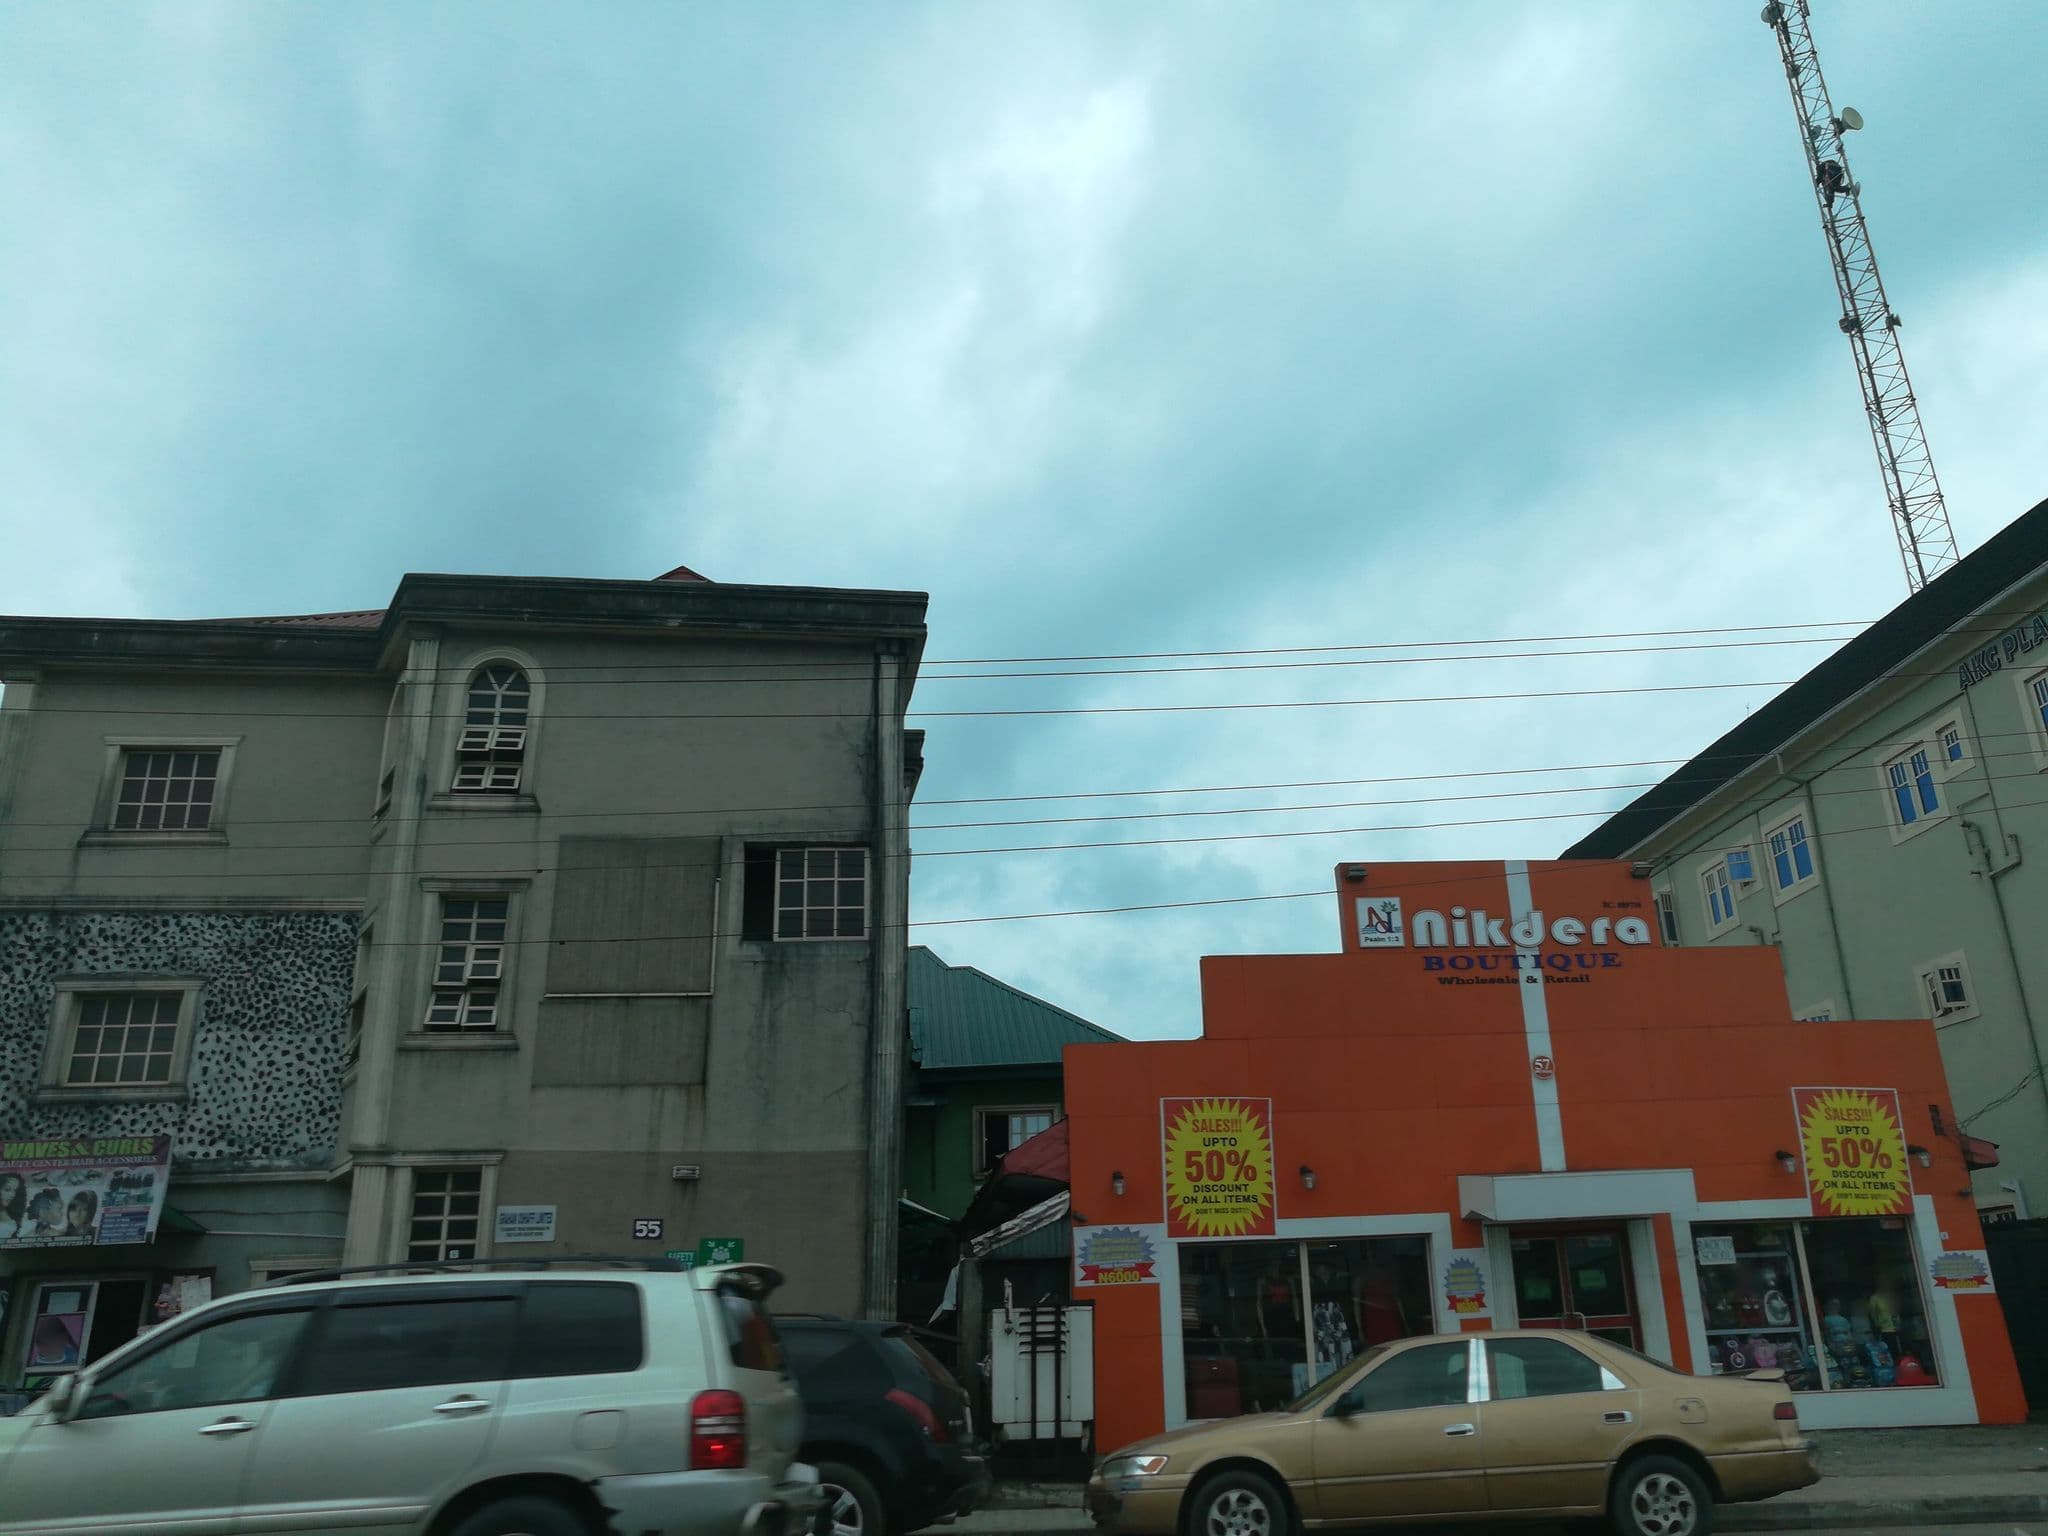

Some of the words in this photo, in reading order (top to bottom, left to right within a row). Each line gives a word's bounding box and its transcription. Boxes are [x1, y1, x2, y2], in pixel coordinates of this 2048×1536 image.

[1958, 645, 2001, 691] AKC
[1423, 952, 1623, 972] BOUTIQUE
[1438, 975, 1519, 985] Wholesale
[1526, 975, 1539, 985] &
[1545, 974, 1591, 985] Retail
[1192, 1118, 1243, 1133] SALES!!!
[3, 1141, 71, 1160] WAVES
[1821, 1137, 1893, 1169] 50%
[1184, 1149, 1257, 1183] 50%
[1832, 1169, 1886, 1179] DISCOUNT
[1193, 1184, 1249, 1193] DISCOUNT
[1823, 1180, 1838, 1189] ON
[1841, 1181, 1860, 1189] ALL
[1863, 1181, 1896, 1190] ITEMS
[1182, 1196, 1198, 1204] ON
[1202, 1195, 1220, 1204] ALL
[1224, 1194, 1258, 1203] ITEMS
[635, 1220, 661, 1238] 55
